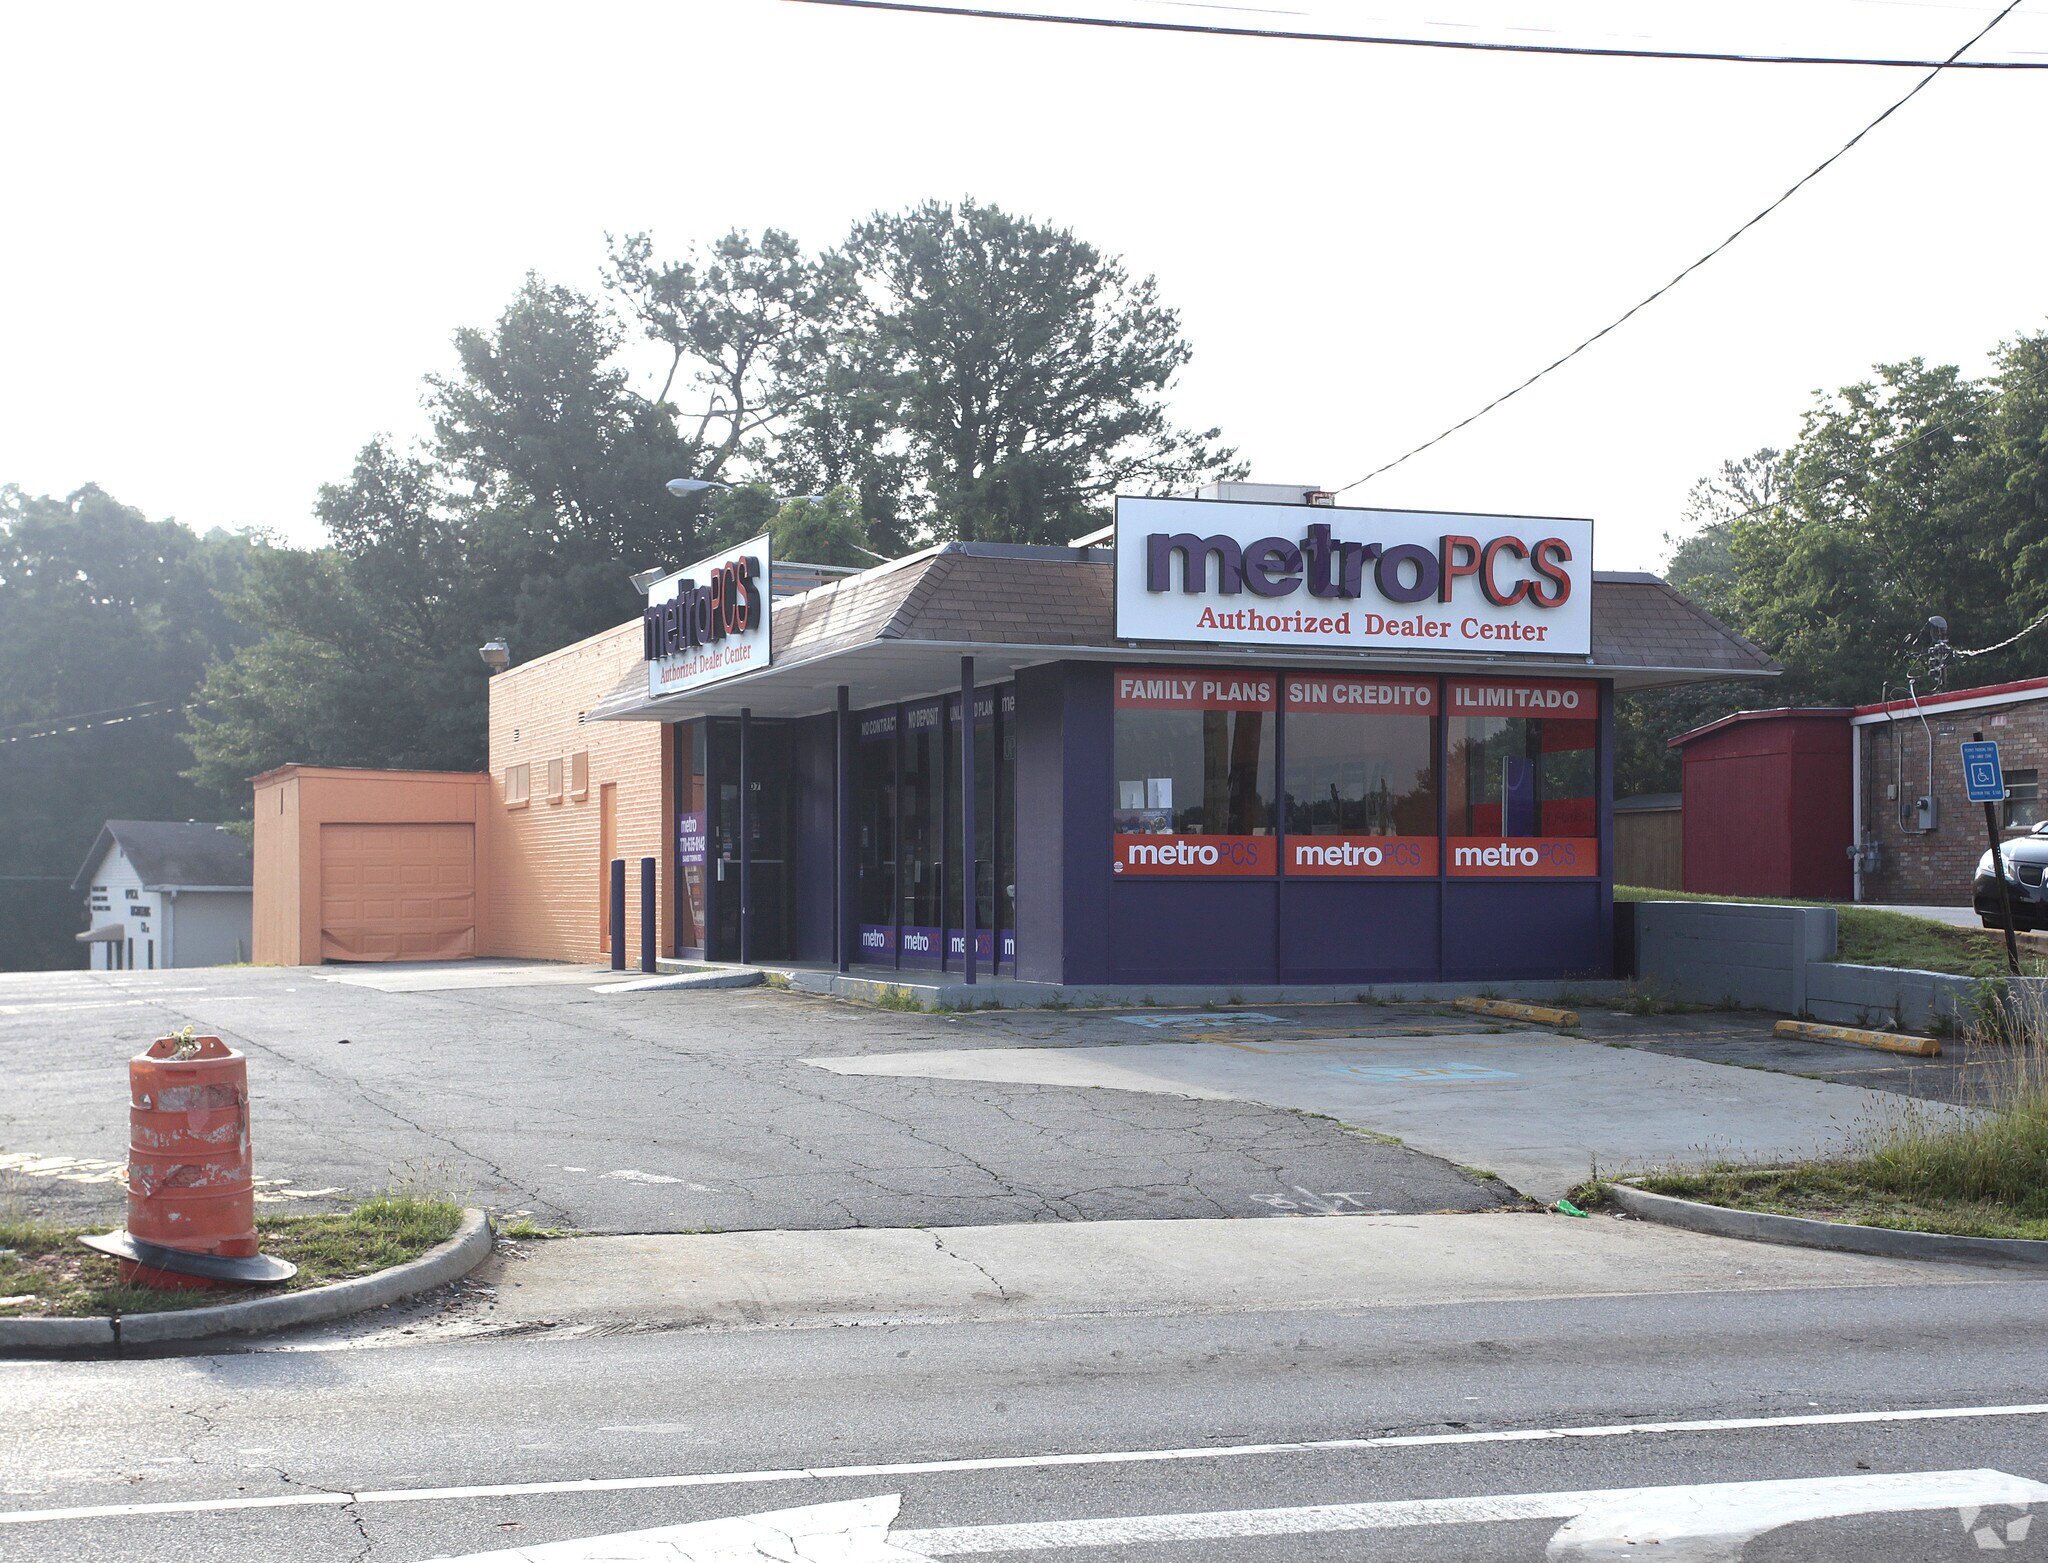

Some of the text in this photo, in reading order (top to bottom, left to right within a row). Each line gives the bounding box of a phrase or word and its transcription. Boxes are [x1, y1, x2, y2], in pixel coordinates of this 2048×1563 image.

[1147, 523, 1572, 608] metroPCS
[643, 556, 761, 661] metroPCS
[1197, 607, 1548, 642] Authorized Dealer Center
[660, 644, 752, 684] Authorized Dealer Center
[1120, 679, 1271, 702] FAMILY PLANS
[1289, 683, 1432, 706] SIN CREDITO
[1455, 687, 1579, 710] ILIMITADO
[861, 716, 897, 736] NO CONTRACT
[908, 707, 939, 728] NO DEPOSIT
[1129, 840, 1258, 866] metroPCS
[1296, 842, 1421, 867] metroPCS
[1455, 843, 1576, 867] metroPCS
